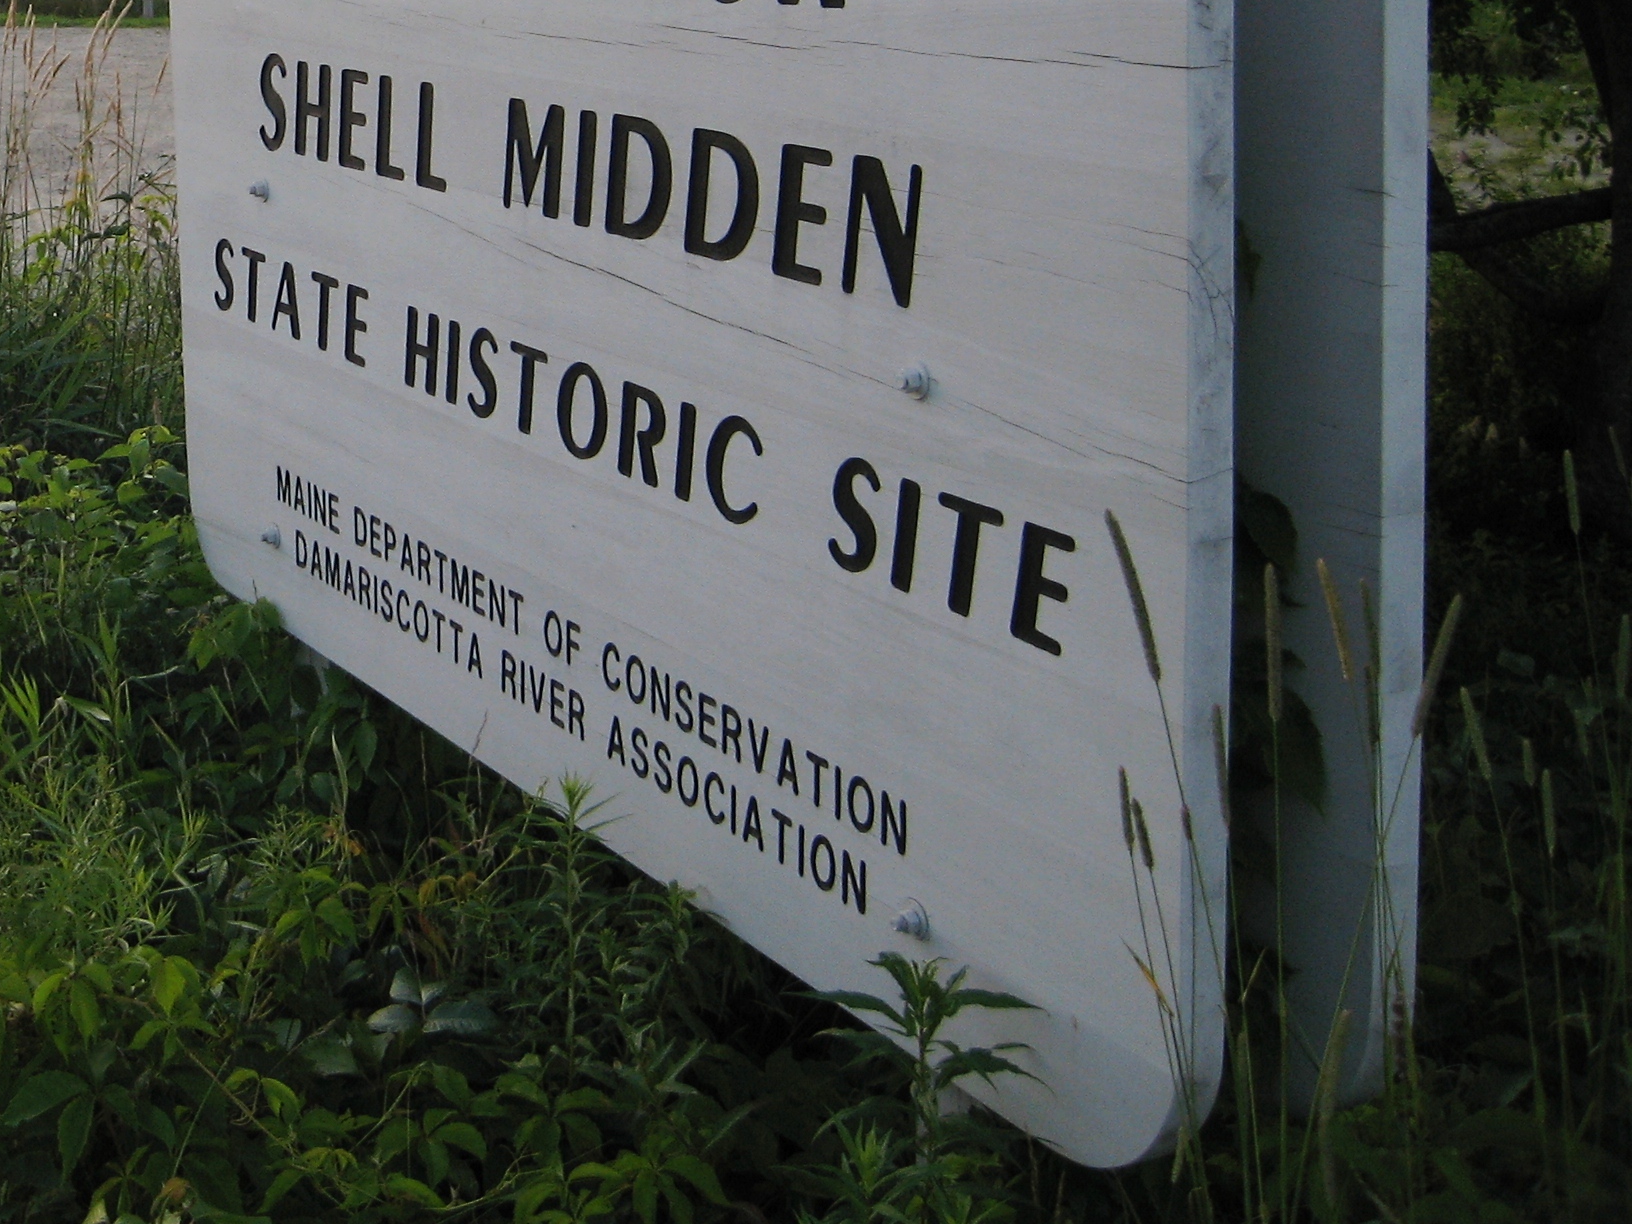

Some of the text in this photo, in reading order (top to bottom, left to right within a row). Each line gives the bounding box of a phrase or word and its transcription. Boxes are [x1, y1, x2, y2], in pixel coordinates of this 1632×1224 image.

[260, 53, 923, 308] SHELL MIDDEN
[215, 239, 1076, 656] STATE HISTORIC SITE
[276, 466, 908, 856] MAINE DEPARTMENT OF CONSERVATION
[295, 529, 867, 914] DAMARISCOTTA RIVER ASSOCIATION
